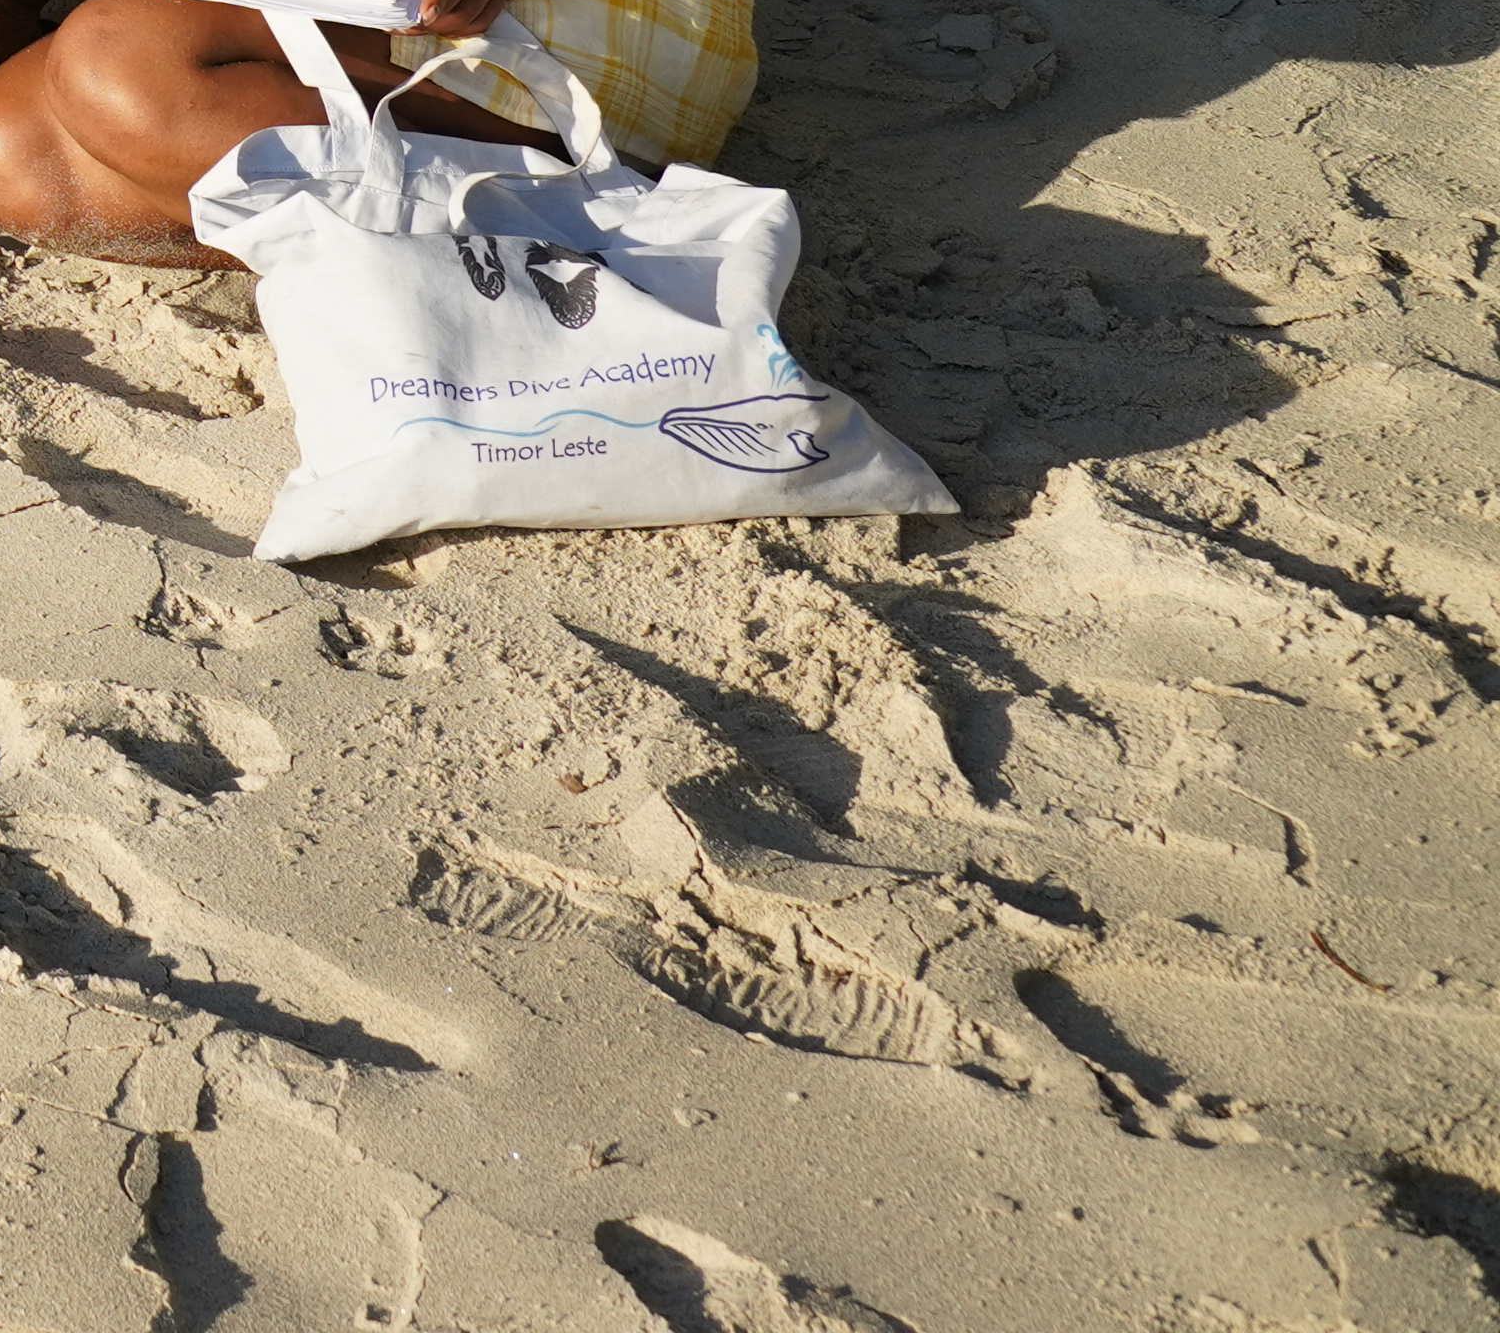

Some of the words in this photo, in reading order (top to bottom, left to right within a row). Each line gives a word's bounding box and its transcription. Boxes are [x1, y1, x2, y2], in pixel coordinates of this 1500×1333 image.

[369, 373, 499, 404] Dreamers
[508, 373, 573, 399] Dive
[578, 350, 717, 393] Academy
[470, 437, 547, 464] Timor
[552, 435, 609, 460] Leste
